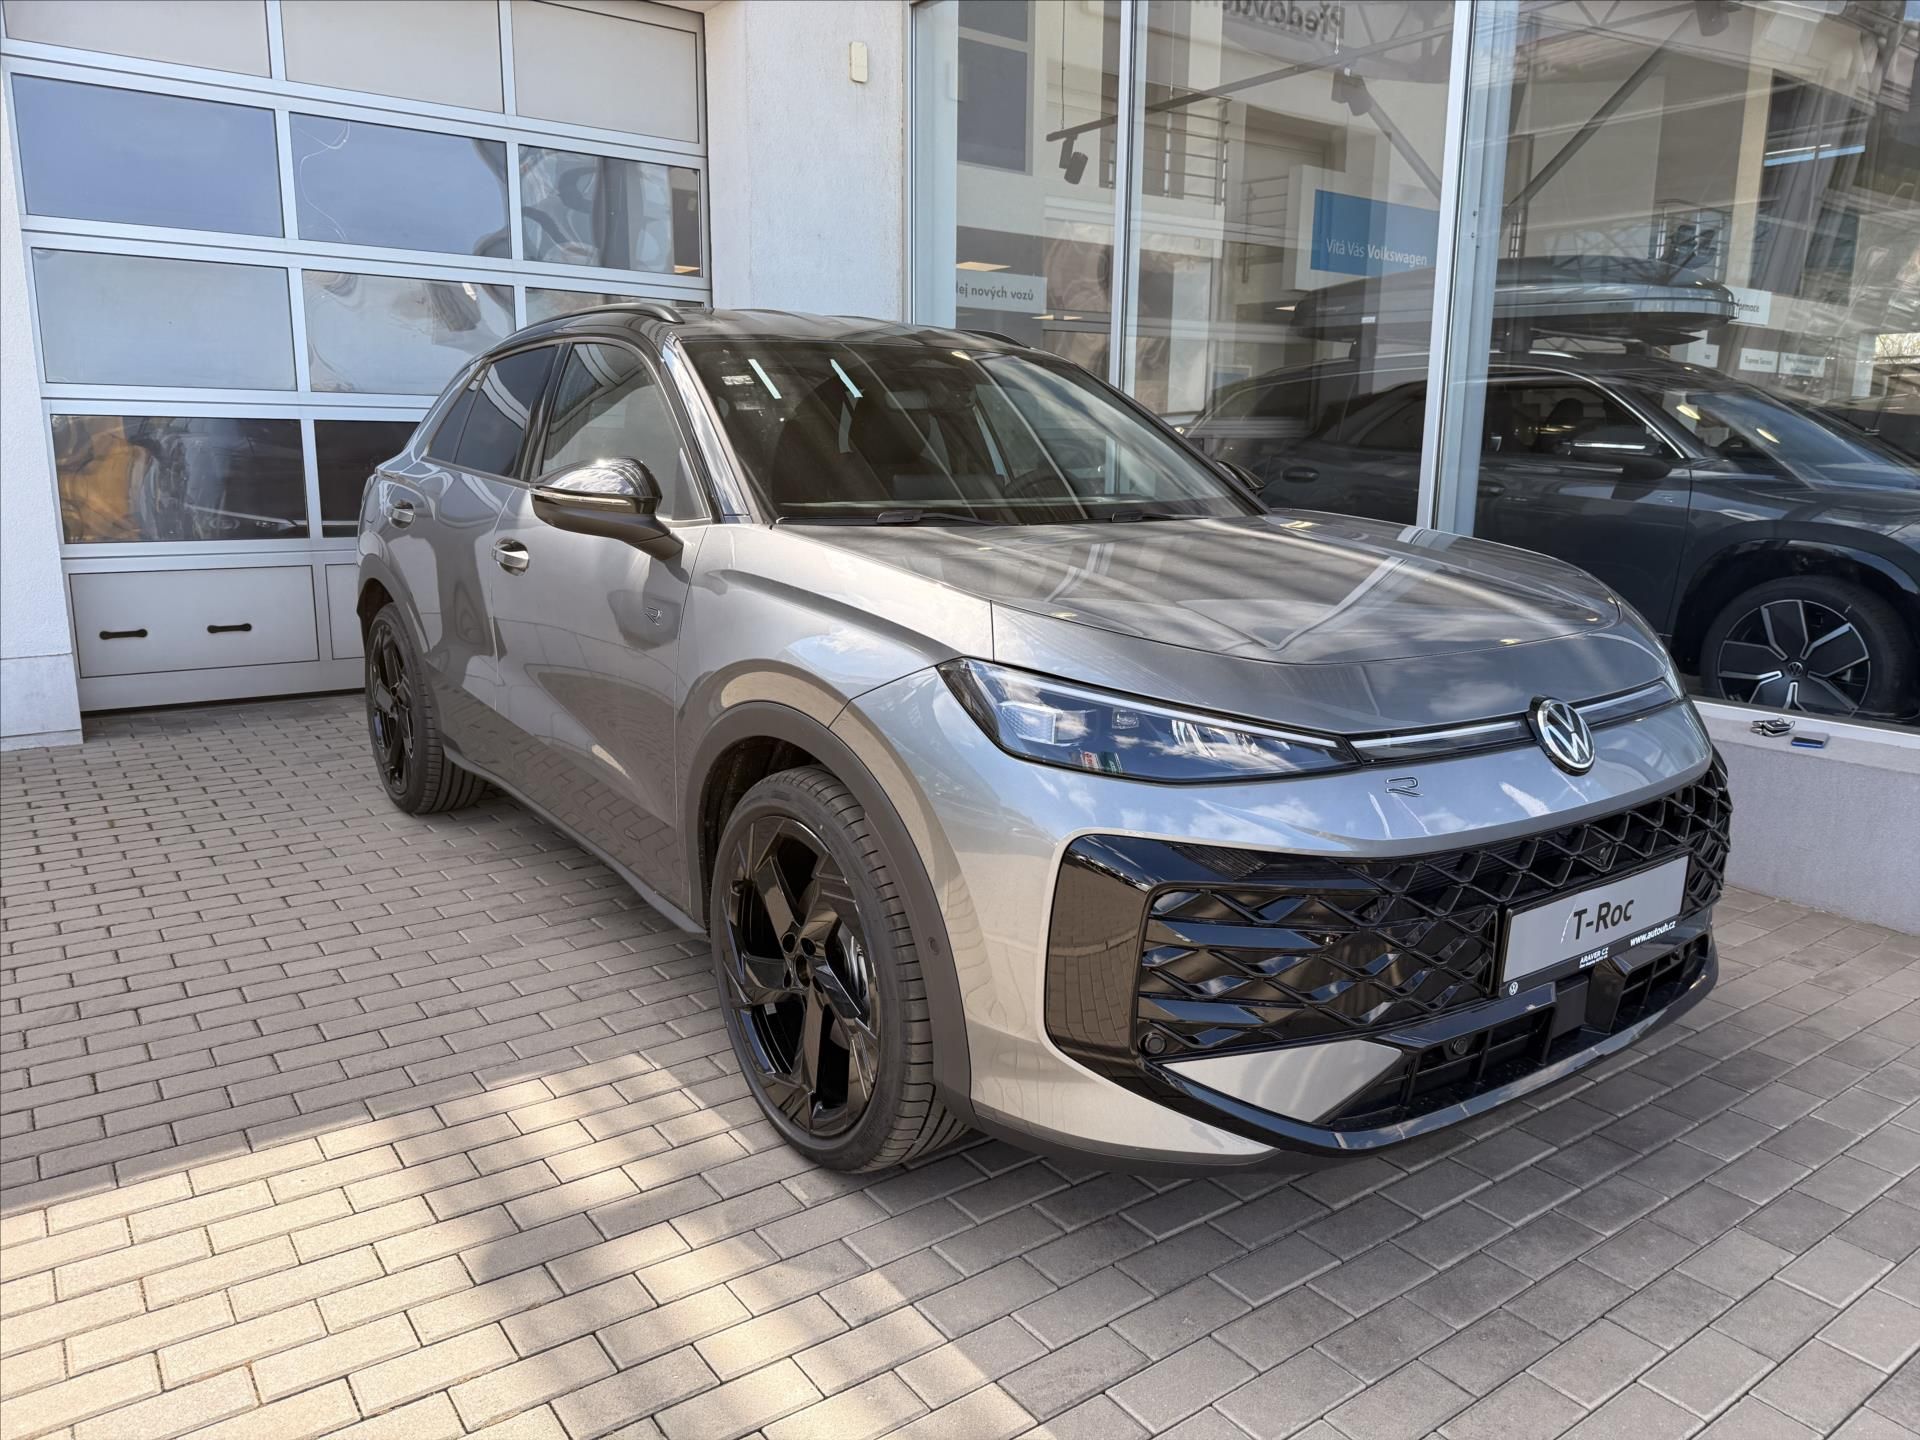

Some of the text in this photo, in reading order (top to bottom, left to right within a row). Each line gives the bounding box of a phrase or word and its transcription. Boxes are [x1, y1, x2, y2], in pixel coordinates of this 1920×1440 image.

[1326, 238, 1428, 268] Vitá Vás Volkswagen
[971, 286, 1007, 300] nových
[1010, 289, 1034, 300] vozů
[1573, 899, 1634, 940] T-Roc
